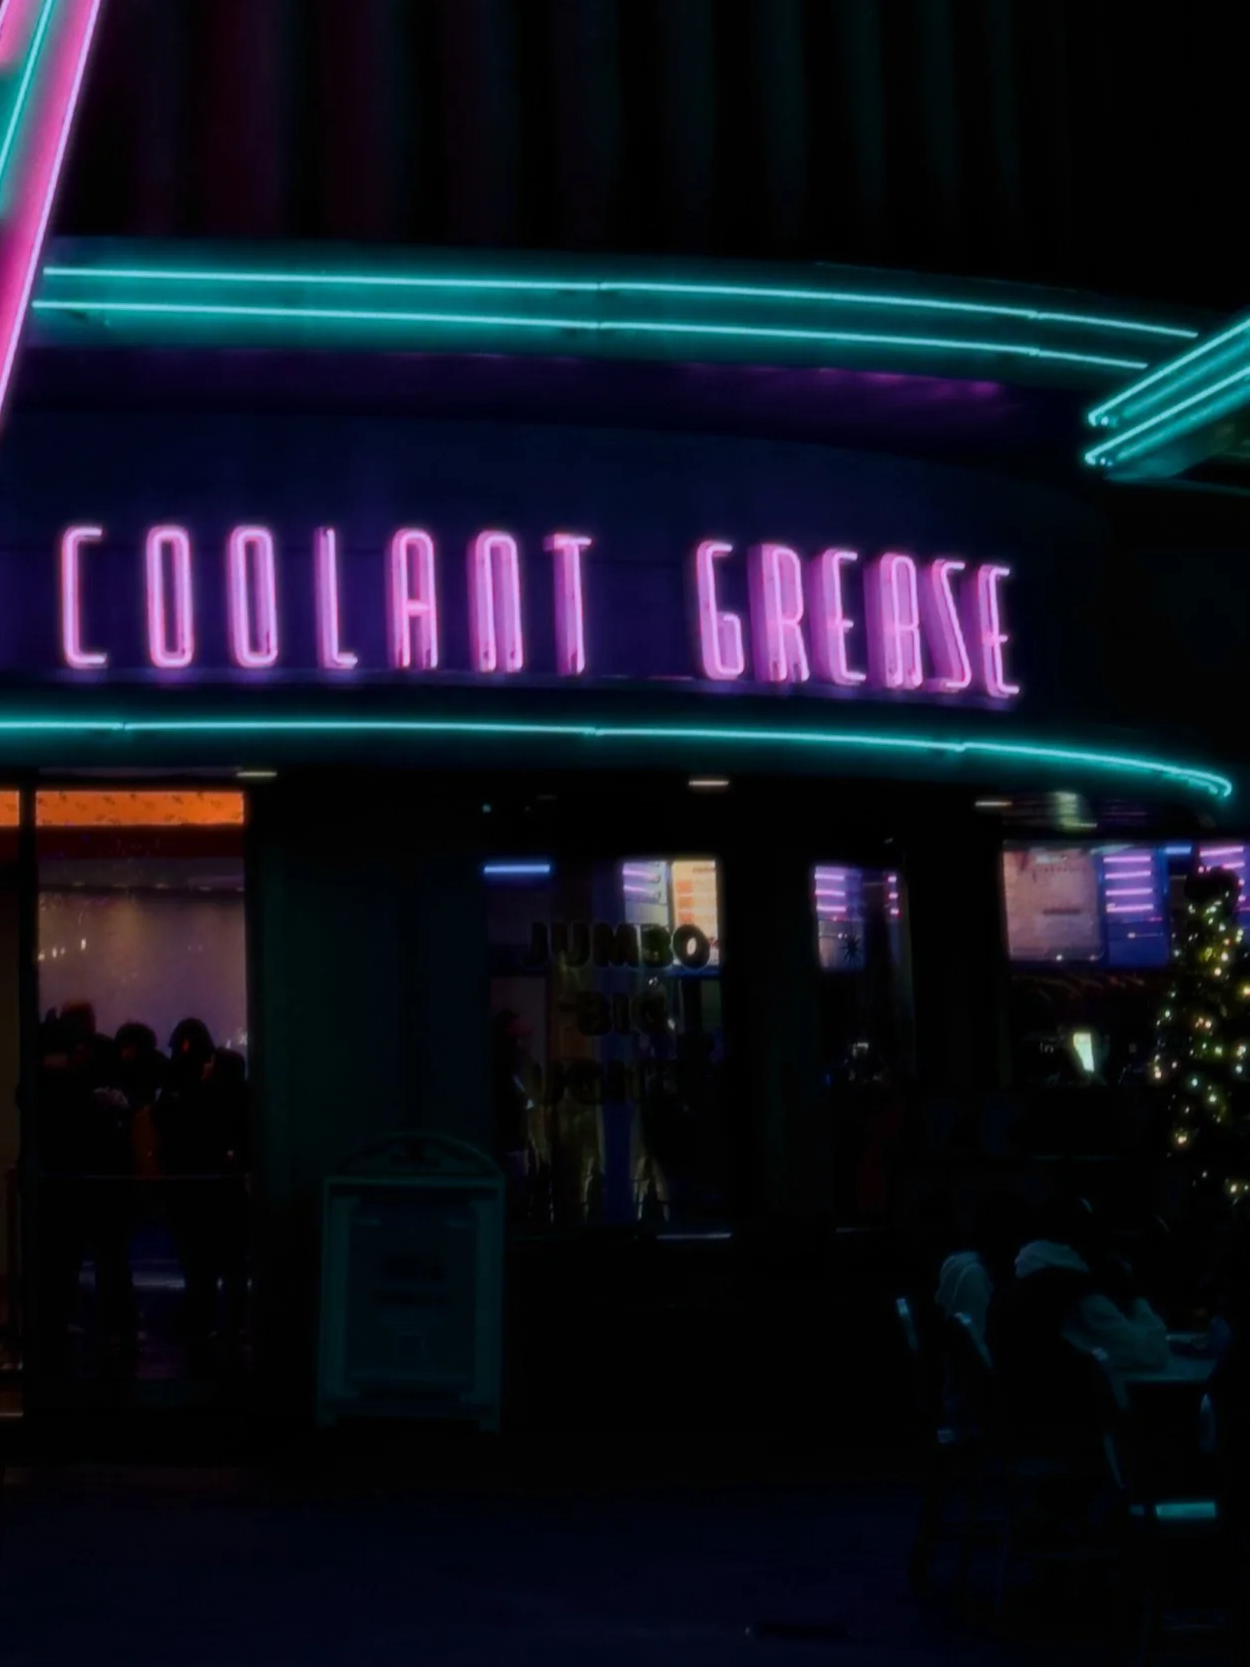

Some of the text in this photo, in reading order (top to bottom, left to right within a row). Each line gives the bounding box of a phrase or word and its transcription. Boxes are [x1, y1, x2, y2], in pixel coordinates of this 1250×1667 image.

[60, 525, 593, 677] COOLANT
[695, 539, 1021, 698] GREASE
[521, 921, 710, 970] JUMBO
